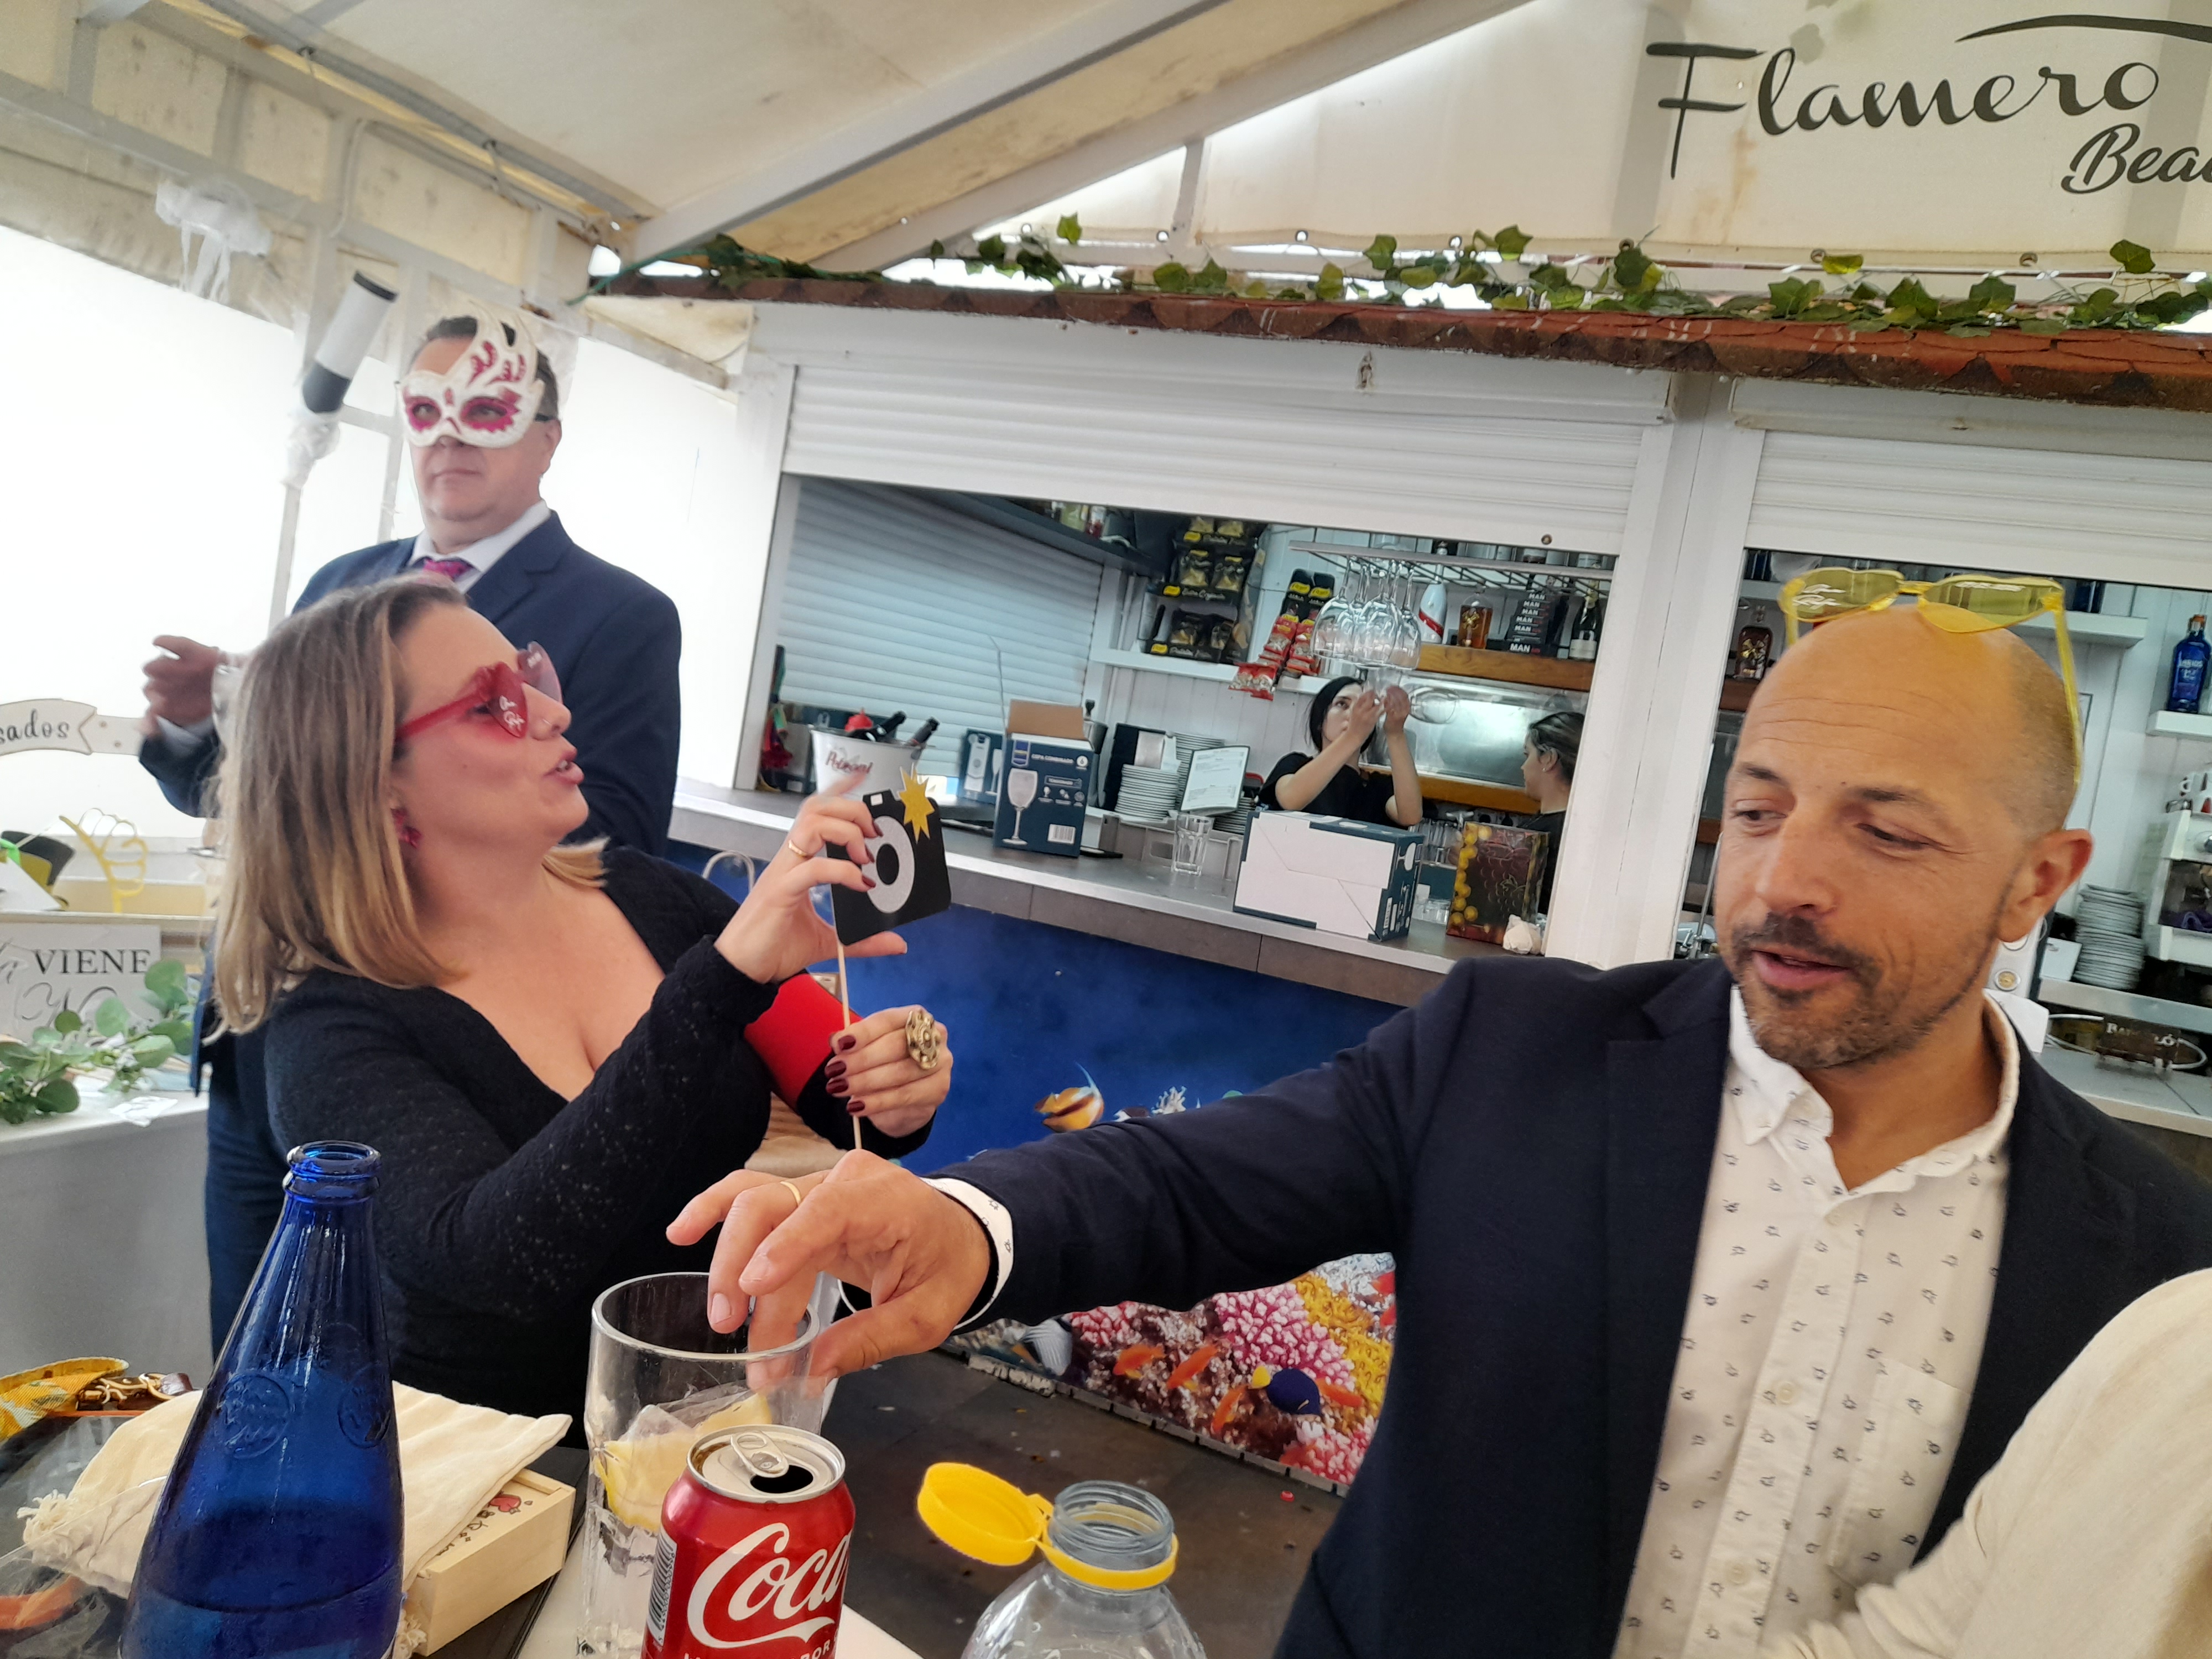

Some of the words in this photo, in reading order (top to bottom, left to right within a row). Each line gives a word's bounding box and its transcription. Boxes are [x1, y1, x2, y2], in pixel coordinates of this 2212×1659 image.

[1645, 41, 2159, 180] Flamero
[1510, 643, 1531, 653] MAN
[32, 948, 150, 974] VIENE
